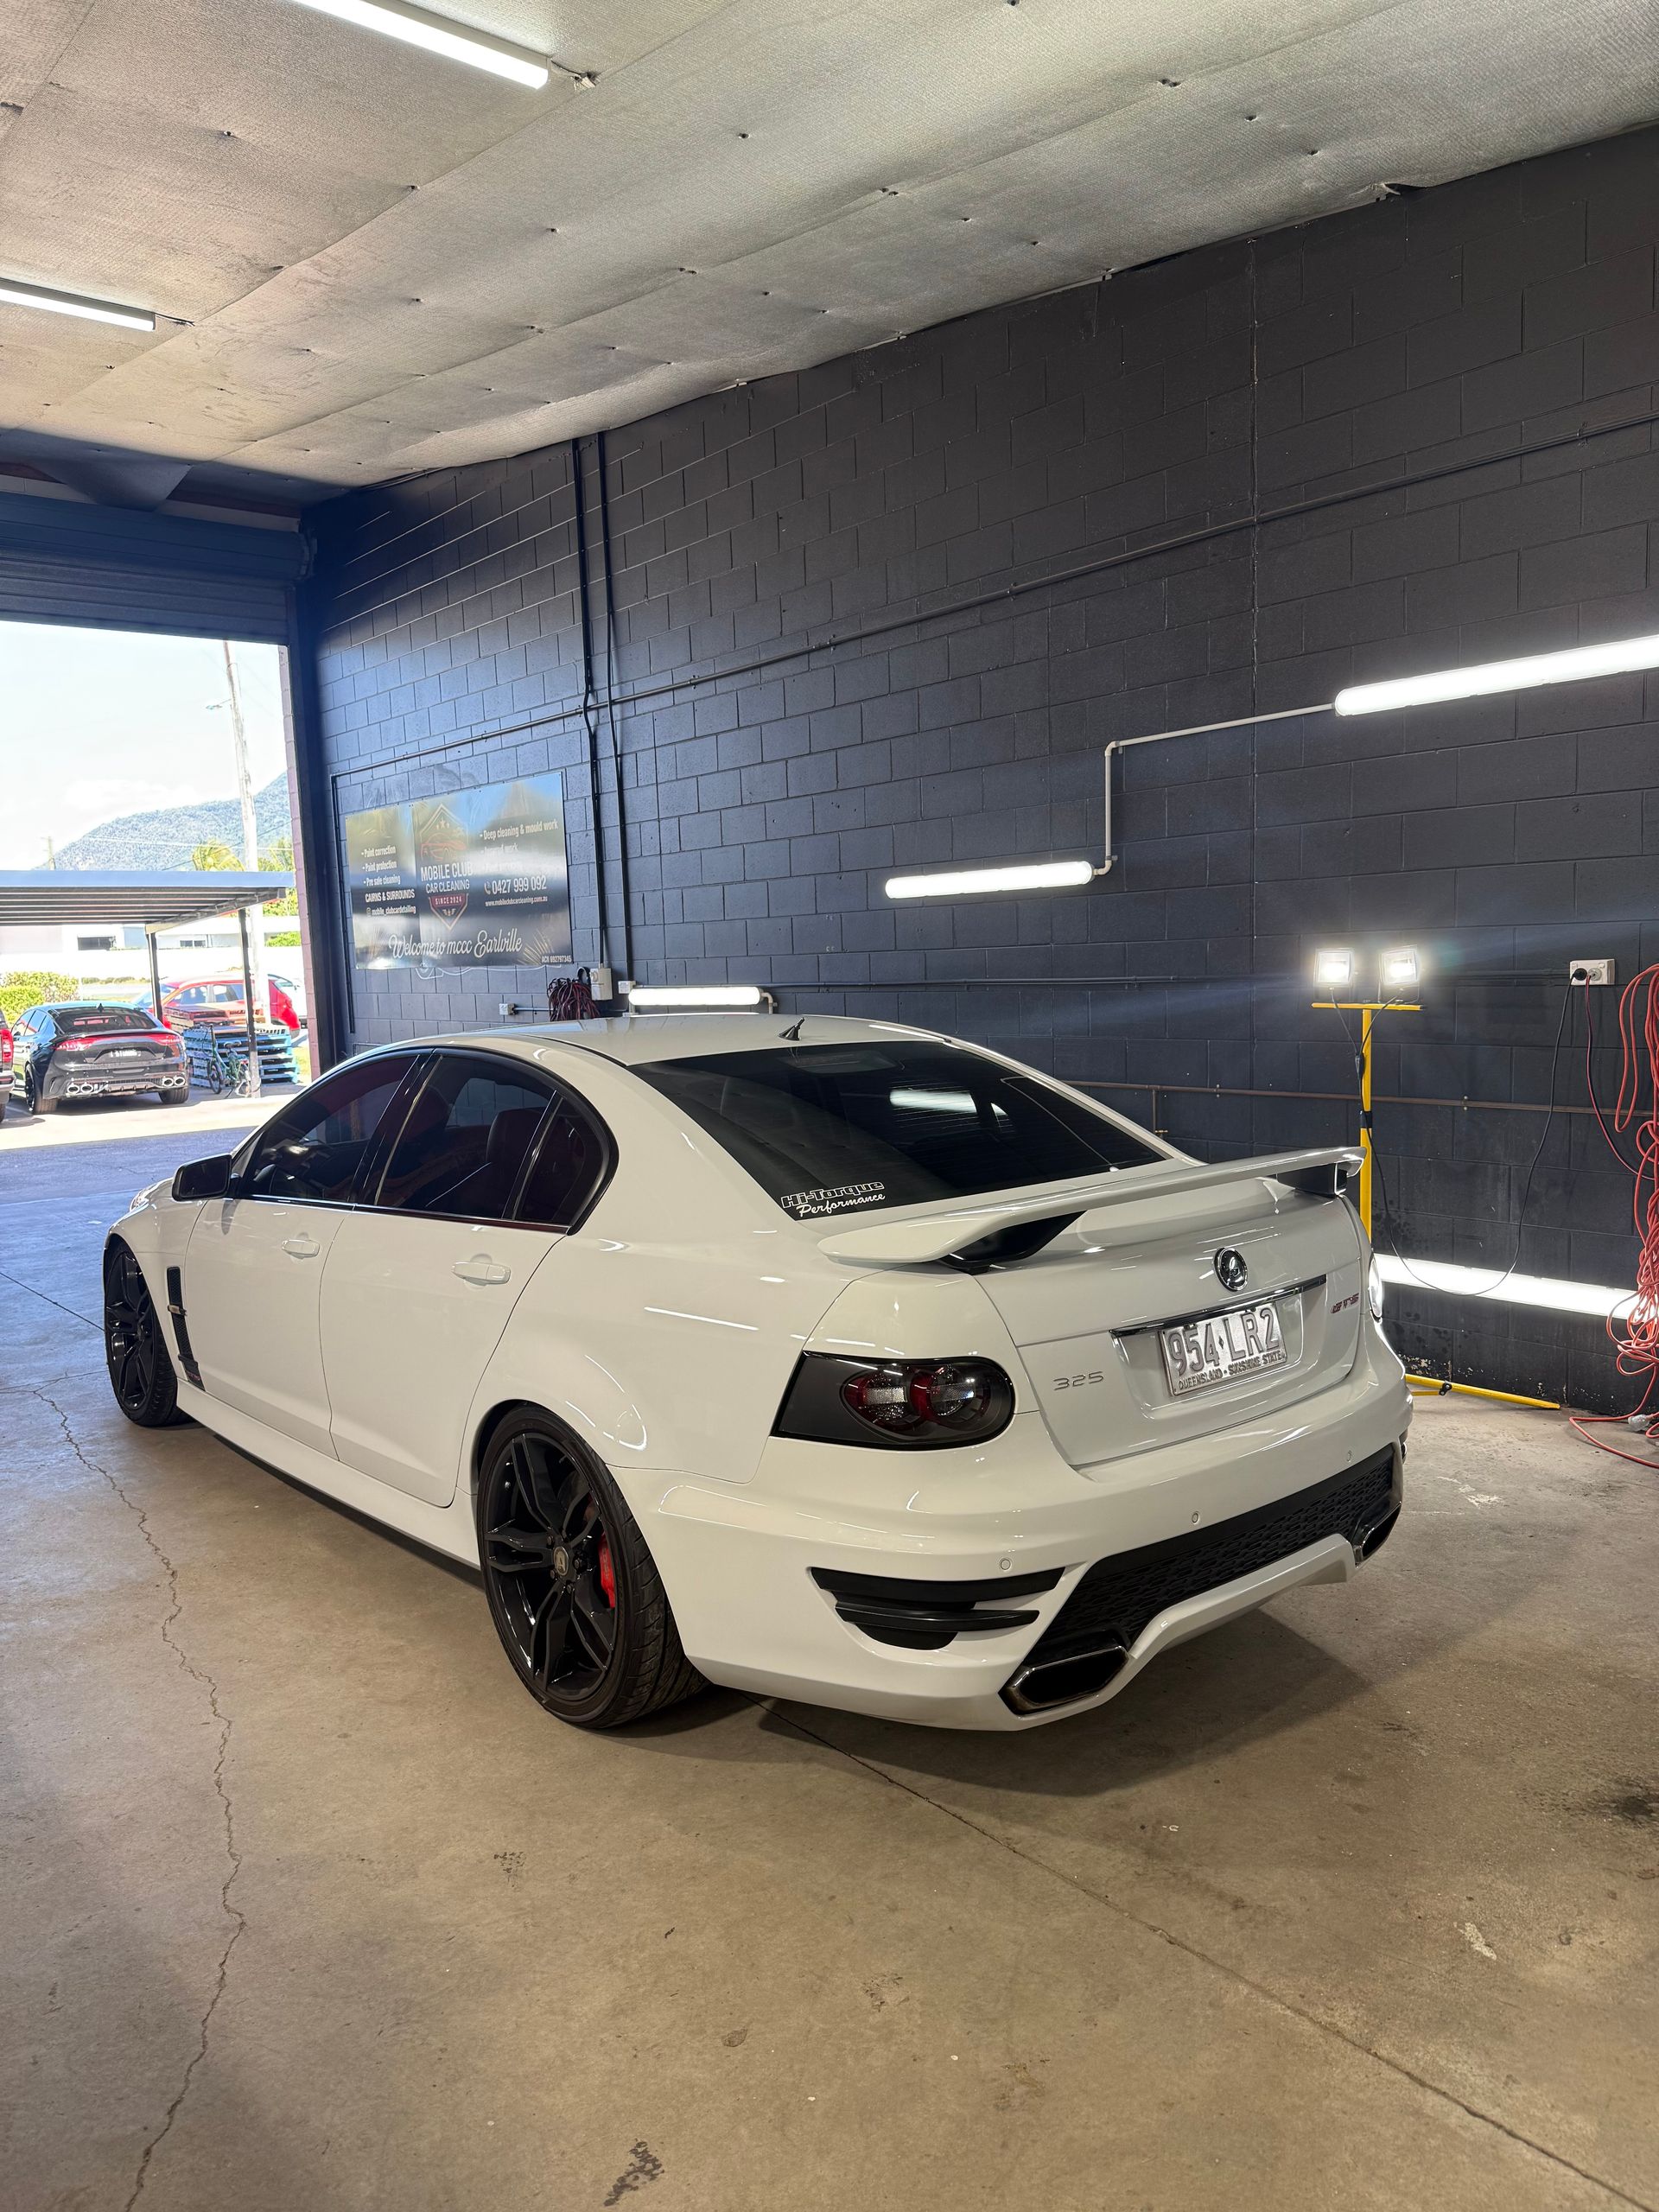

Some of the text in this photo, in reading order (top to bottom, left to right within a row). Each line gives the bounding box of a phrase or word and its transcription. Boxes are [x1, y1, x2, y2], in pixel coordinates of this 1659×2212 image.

[484, 818, 558, 841] Deep cleaning & mould work
[364, 845, 396, 857] Paint correction
[365, 860, 397, 873] Paint protection
[421, 863, 450, 881] MOBILE
[452, 861, 473, 878] CLUB
[383, 874, 401, 885] cleaning
[426, 879, 470, 893] CAR CLEANING
[492, 875, 547, 894] 0427 999 092
[365, 889, 415, 903] CAIRNS & SURROUNDS
[435, 897, 449, 906] SINCE
[389, 928, 523, 958] Welcome to mccc Earlville
[781, 1181, 885, 1209] Hi-Torque
[796, 1193, 886, 1217] Performance
[1179, 1350, 1282, 1390] QUEENSLAND SUNSHINE STATE
[1053, 1370, 1104, 1391] 325
